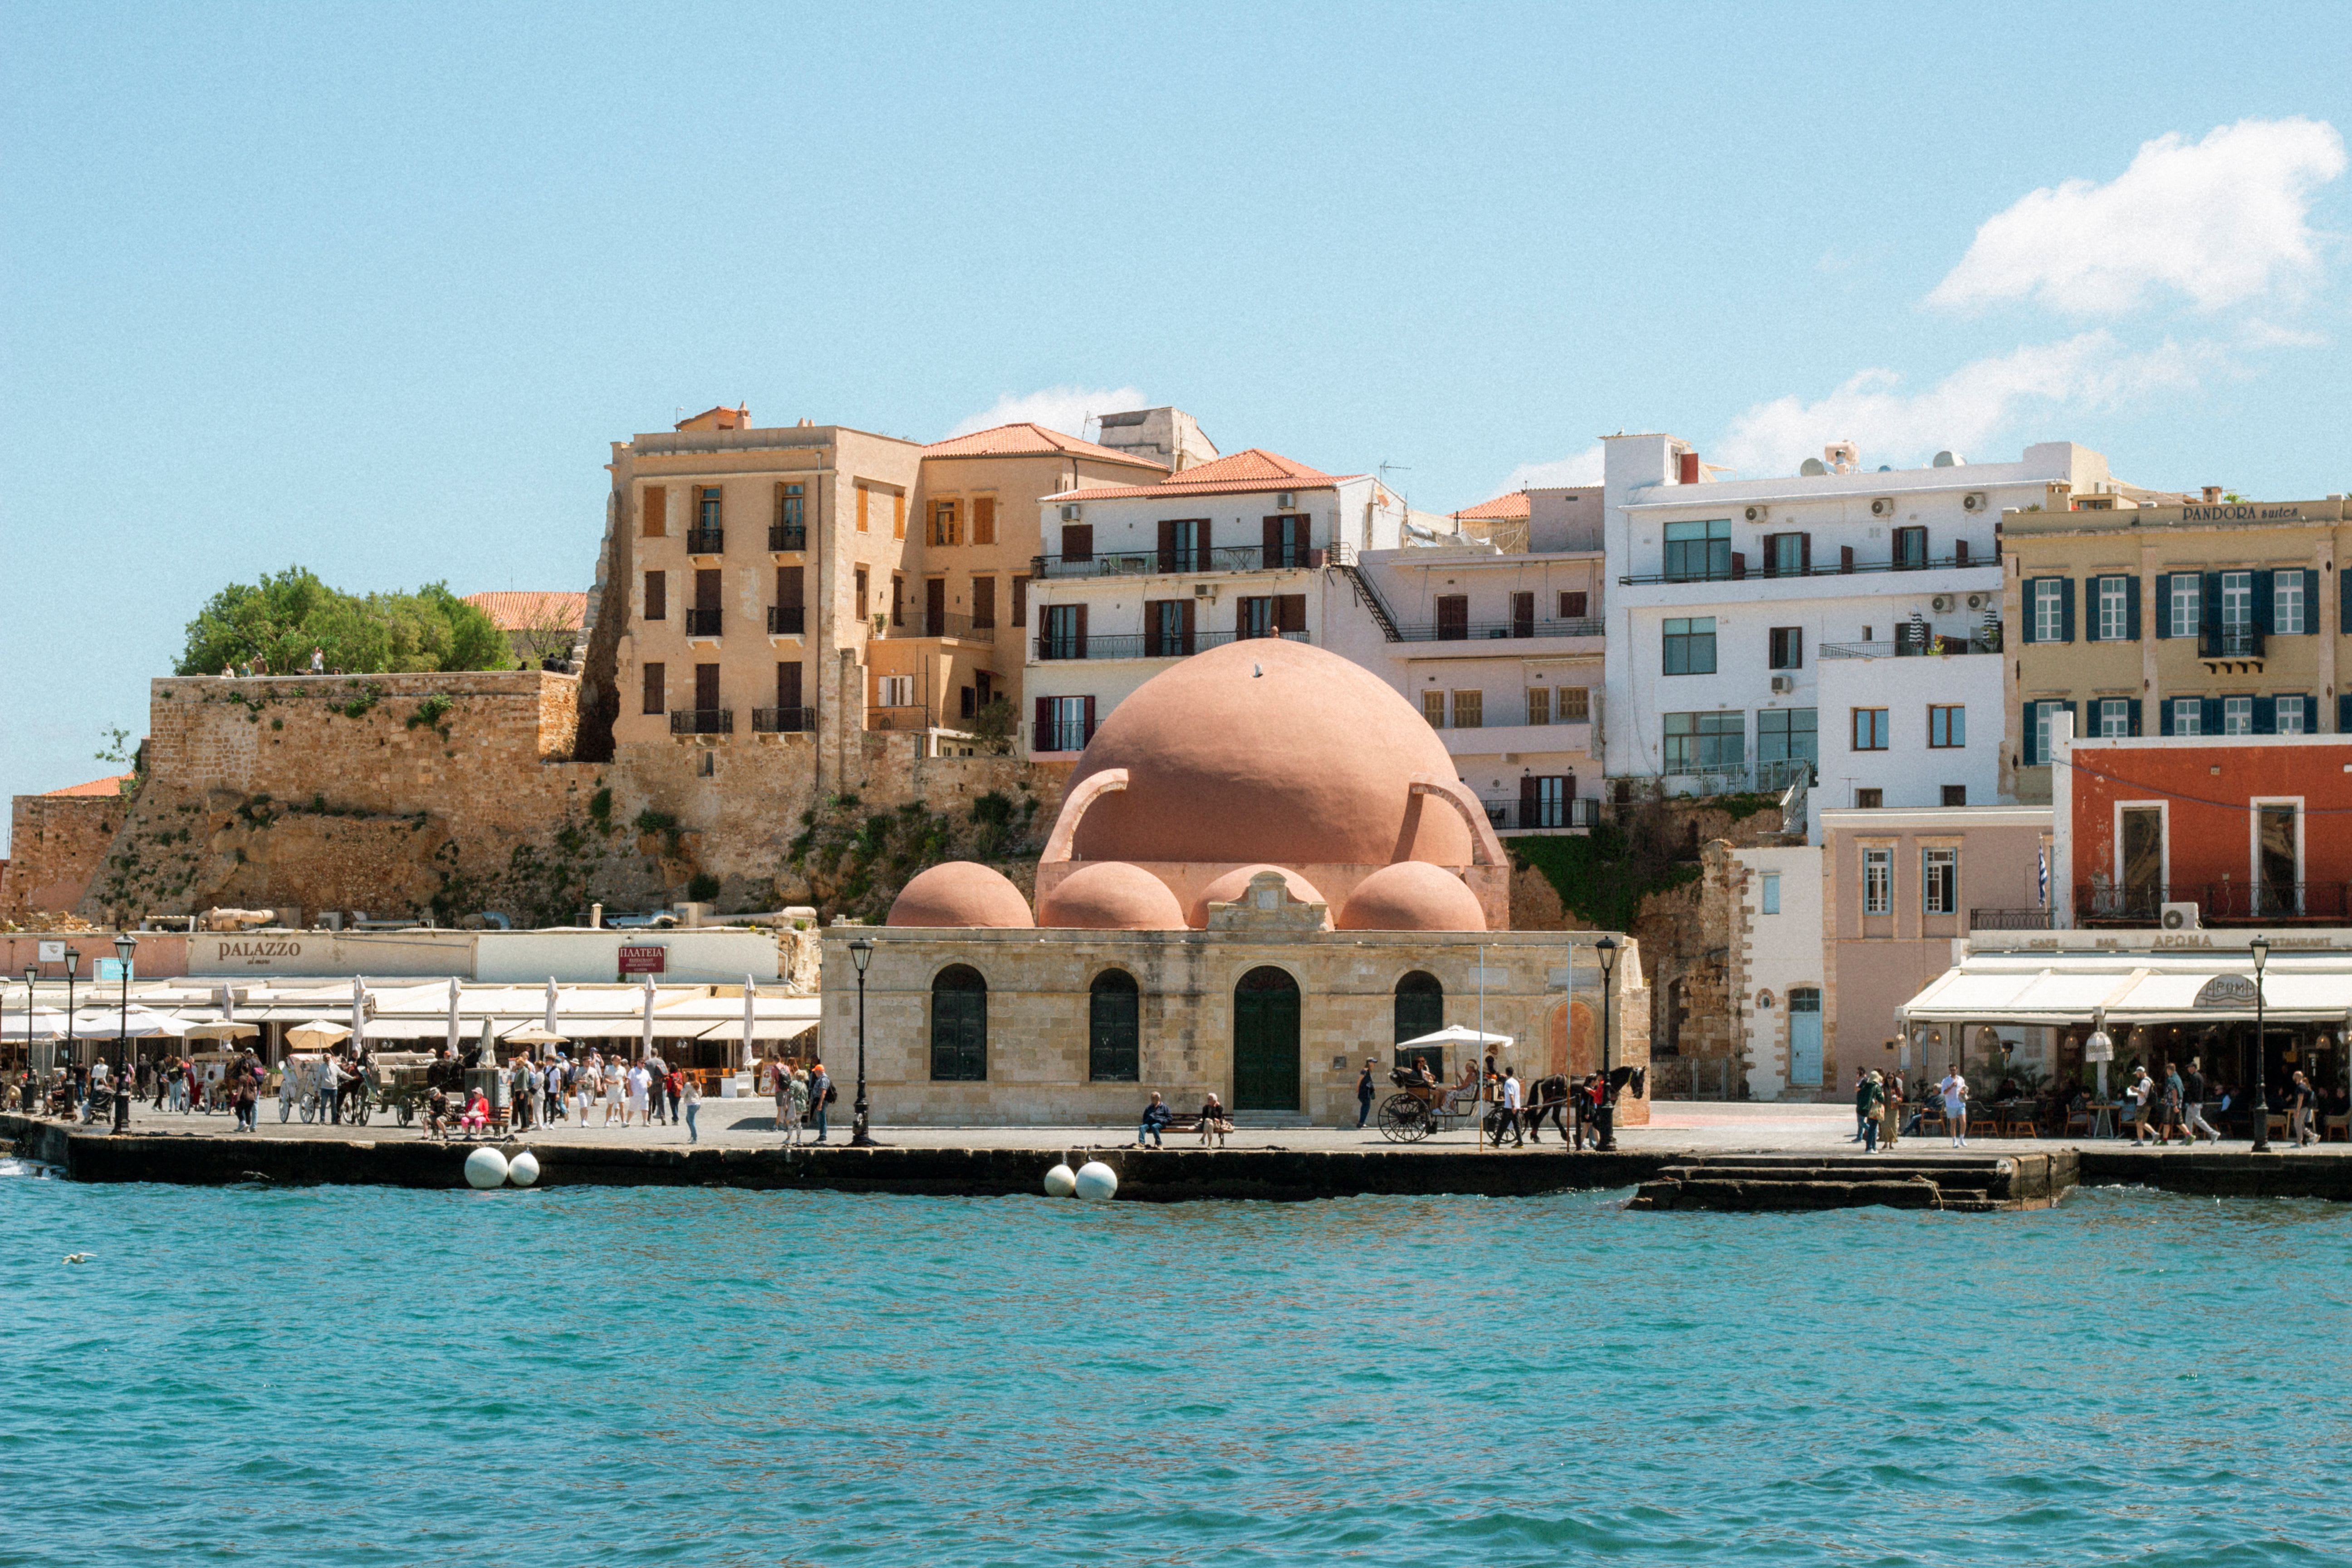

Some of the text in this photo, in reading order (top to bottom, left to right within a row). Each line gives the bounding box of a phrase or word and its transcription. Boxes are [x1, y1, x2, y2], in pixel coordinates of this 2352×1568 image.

[2183, 506, 2298, 520] PANDORA suites
[2096, 938, 2117, 947] BAR
[218, 942, 301, 960] PALAZZO
[620, 948, 662, 957] ΠΛΑΤΕΙΑ
[247, 956, 255, 965] al
[104, 962, 131, 972] PALAZO
